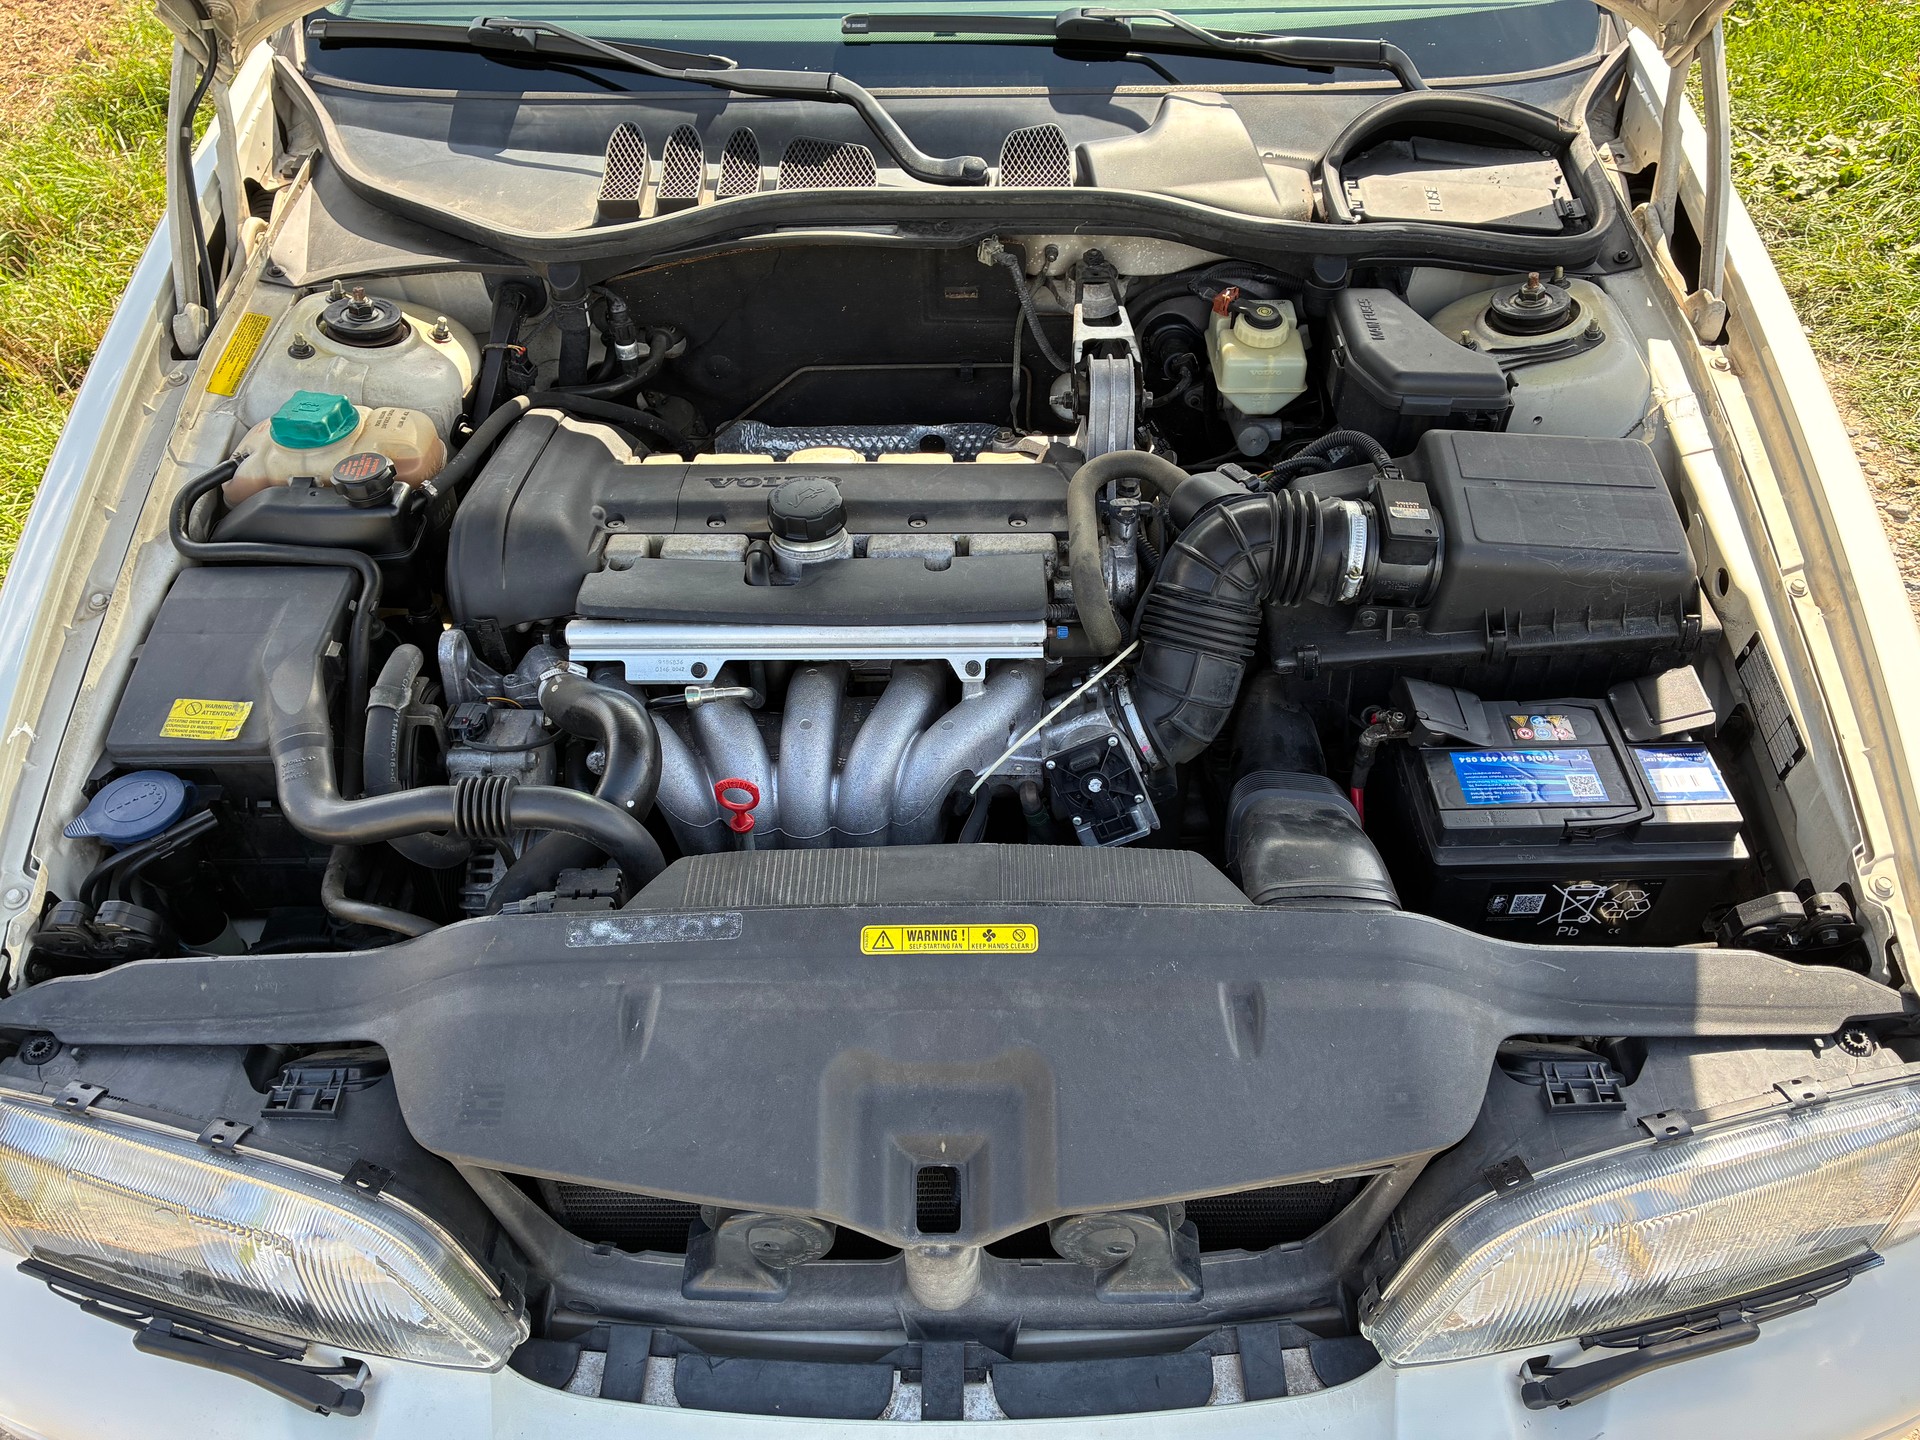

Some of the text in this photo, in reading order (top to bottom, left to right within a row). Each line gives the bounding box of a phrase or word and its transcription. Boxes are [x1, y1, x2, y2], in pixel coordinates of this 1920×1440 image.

[1424, 186, 1443, 211] FUSE
[907, 929, 958, 942] WARNING
[1556, 926, 1580, 937] Pb
